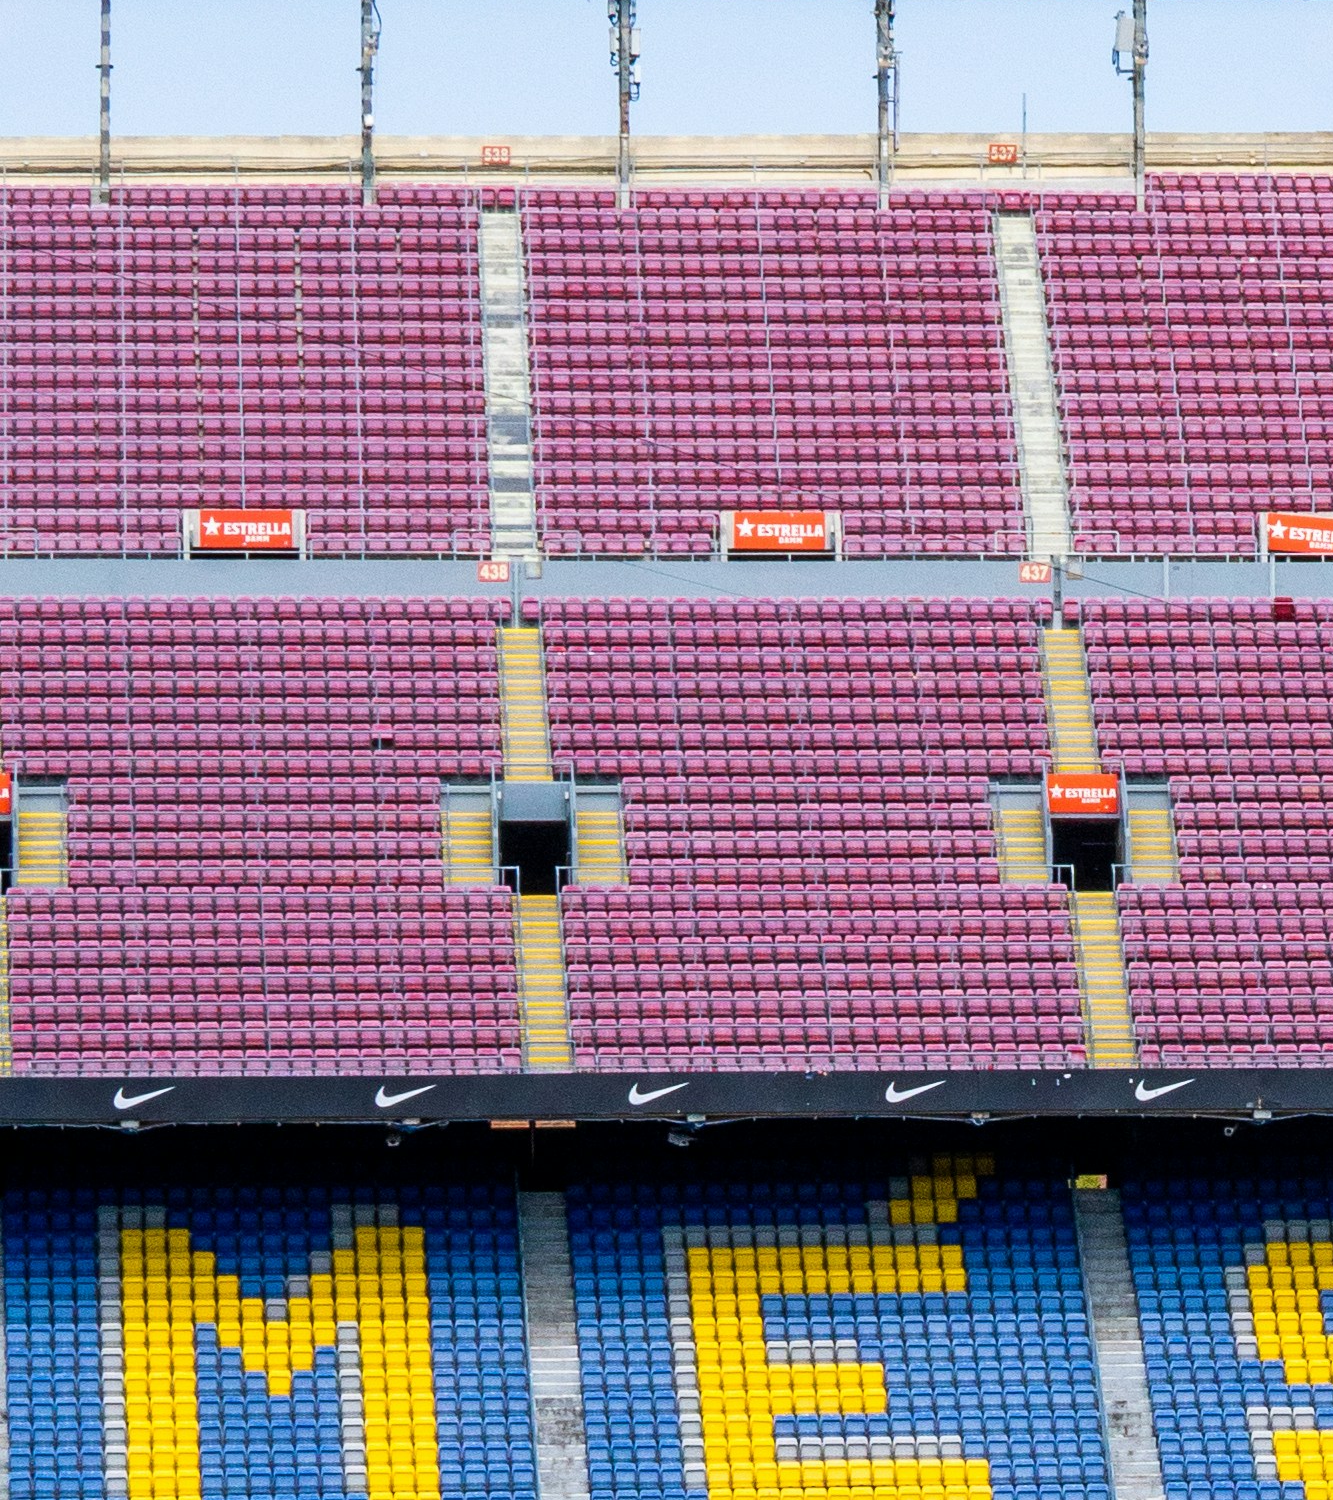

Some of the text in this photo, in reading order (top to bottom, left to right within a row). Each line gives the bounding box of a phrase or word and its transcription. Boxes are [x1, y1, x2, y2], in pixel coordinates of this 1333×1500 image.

[990, 145, 1016, 160] 537
[223, 522, 291, 535] ESTRELLA
[757, 524, 824, 537] ESTRELLA
[480, 565, 509, 580] 438
[1021, 565, 1049, 580] 437
[1065, 788, 1117, 799] ESTRELLA
